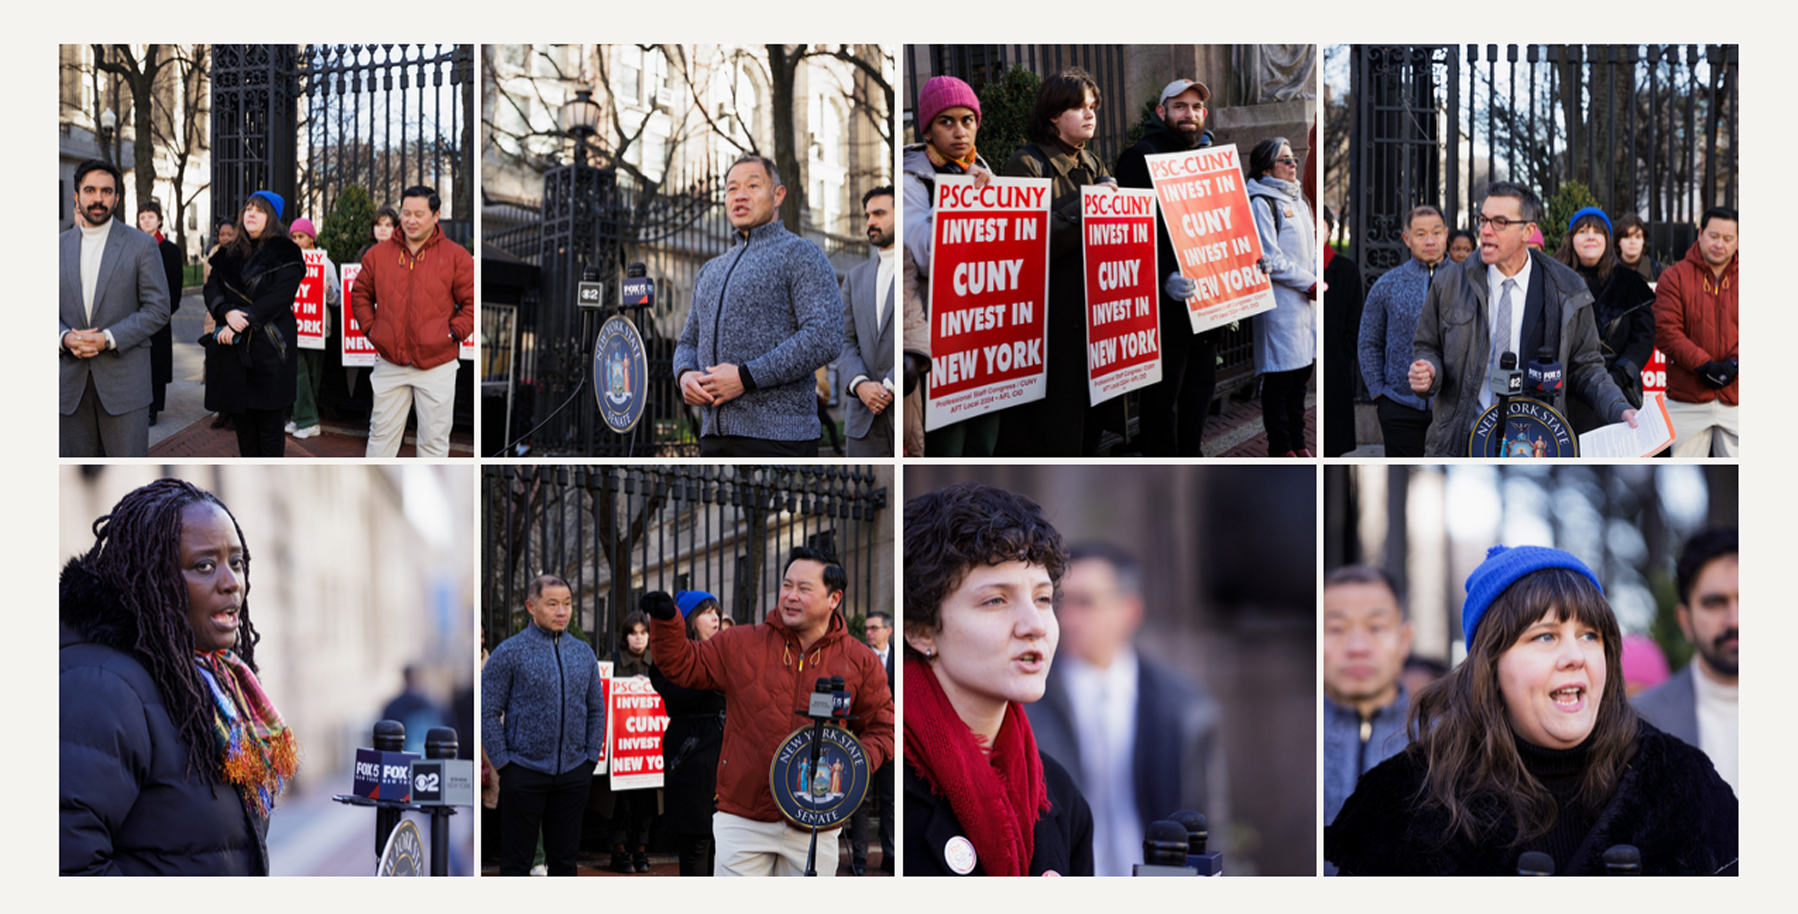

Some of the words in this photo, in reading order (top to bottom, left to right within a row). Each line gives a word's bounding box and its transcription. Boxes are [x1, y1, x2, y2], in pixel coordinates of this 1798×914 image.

[1150, 150, 1234, 178] PSC-CUNY
[938, 184, 1046, 208] PSC-CUNY
[1162, 178, 1212, 203] INVEST
[1216, 174, 1236, 194] IN
[1084, 194, 1152, 215] PSC-CUNY
[942, 218, 1008, 245] INVEST
[1014, 218, 1037, 241] IN
[1088, 223, 1130, 246] INVEST
[1133, 223, 1148, 244] IN
[1182, 206, 1232, 238] CUNY
[1183, 241, 1229, 268] INVEST
[1231, 236, 1252, 256] IN
[953, 258, 1024, 297] CUNY
[1098, 258, 1141, 291] CUNY
[1190, 274, 1220, 304] NEW
[1220, 264, 1267, 294] YORK
[303, 303, 316, 314] IN
[940, 304, 1006, 338] INVEST
[1012, 300, 1033, 326] IN
[1092, 298, 1132, 327] INVEST
[1135, 296, 1150, 318] IN
[298, 319, 322, 334] ORK
[596, 333, 607, 361] NEW
[606, 320, 624, 335] YORK
[624, 326, 641, 360] STATE
[1090, 336, 1117, 370] NEW
[1119, 328, 1158, 360] YORK
[931, 348, 978, 389] NEW
[983, 338, 1042, 375] YORK
[936, 392, 972, 408] Professional
[988, 382, 1016, 396] Congress
[1020, 378, 1038, 388] CUNY
[608, 410, 632, 428] SENATE
[1477, 409, 1499, 438] NEW
[1506, 403, 1539, 416] ORK
[1540, 411, 1570, 446] STATE
[613, 681, 652, 693] PSC-C
[616, 696, 661, 710] INVEST
[626, 715, 670, 733] CUNY
[618, 736, 660, 750] INVEST
[780, 736, 802, 764] NEW
[839, 734, 864, 766] STATE
[613, 756, 644, 772] NEW
[646, 754, 664, 770] YO
[795, 808, 840, 824] SENATE
